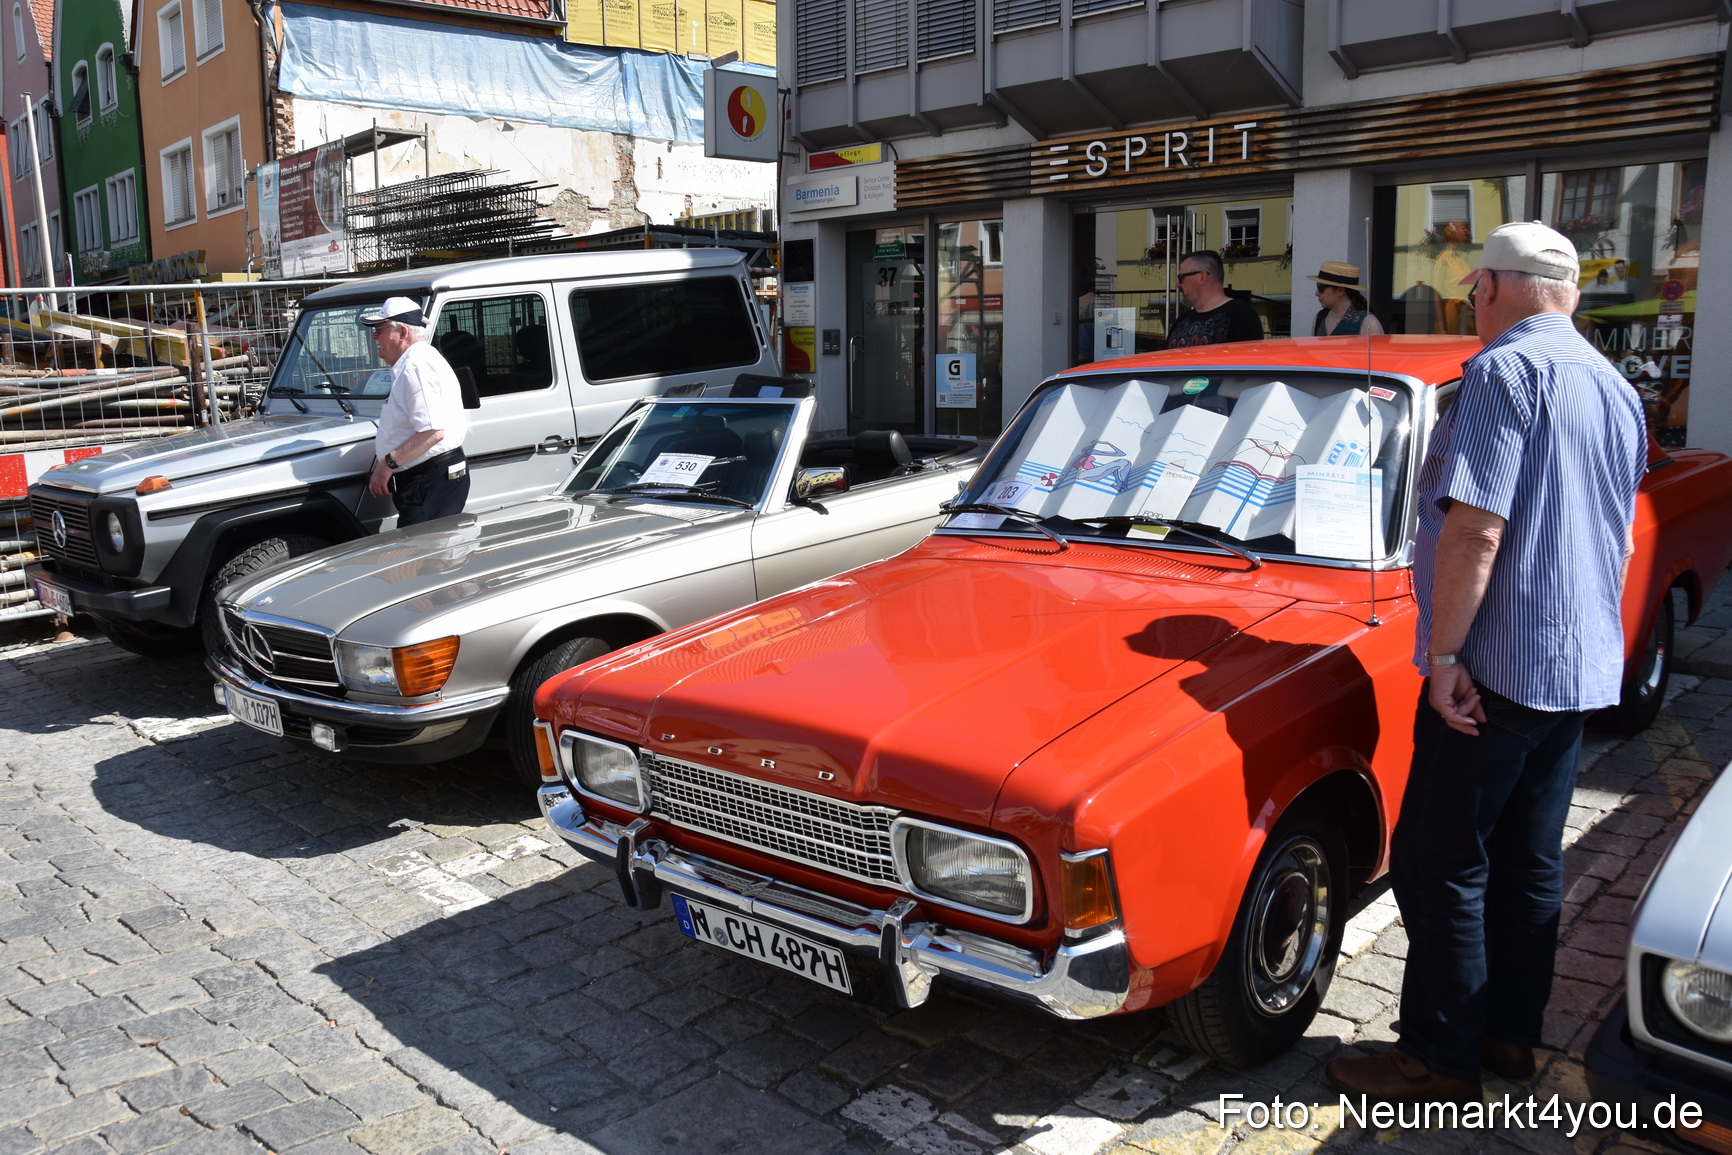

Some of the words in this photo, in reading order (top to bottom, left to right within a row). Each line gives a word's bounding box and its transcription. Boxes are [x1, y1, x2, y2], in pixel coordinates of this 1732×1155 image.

[1050, 122, 1257, 180] ESPRIT
[795, 184, 840, 201] Barmenia
[878, 267, 898, 288] 37
[1585, 326, 1693, 351] MMER
[948, 359, 961, 376] G
[674, 461, 698, 472] 530
[1166, 471, 1195, 481] PREISLISTE
[1307, 470, 1346, 480] MINARTZ
[1143, 510, 1164, 520] FORD
[250, 700, 279, 730] 107H
[660, 732, 836, 782] FORD
[724, 916, 766, 958] CH
[770, 932, 847, 989] 487H
